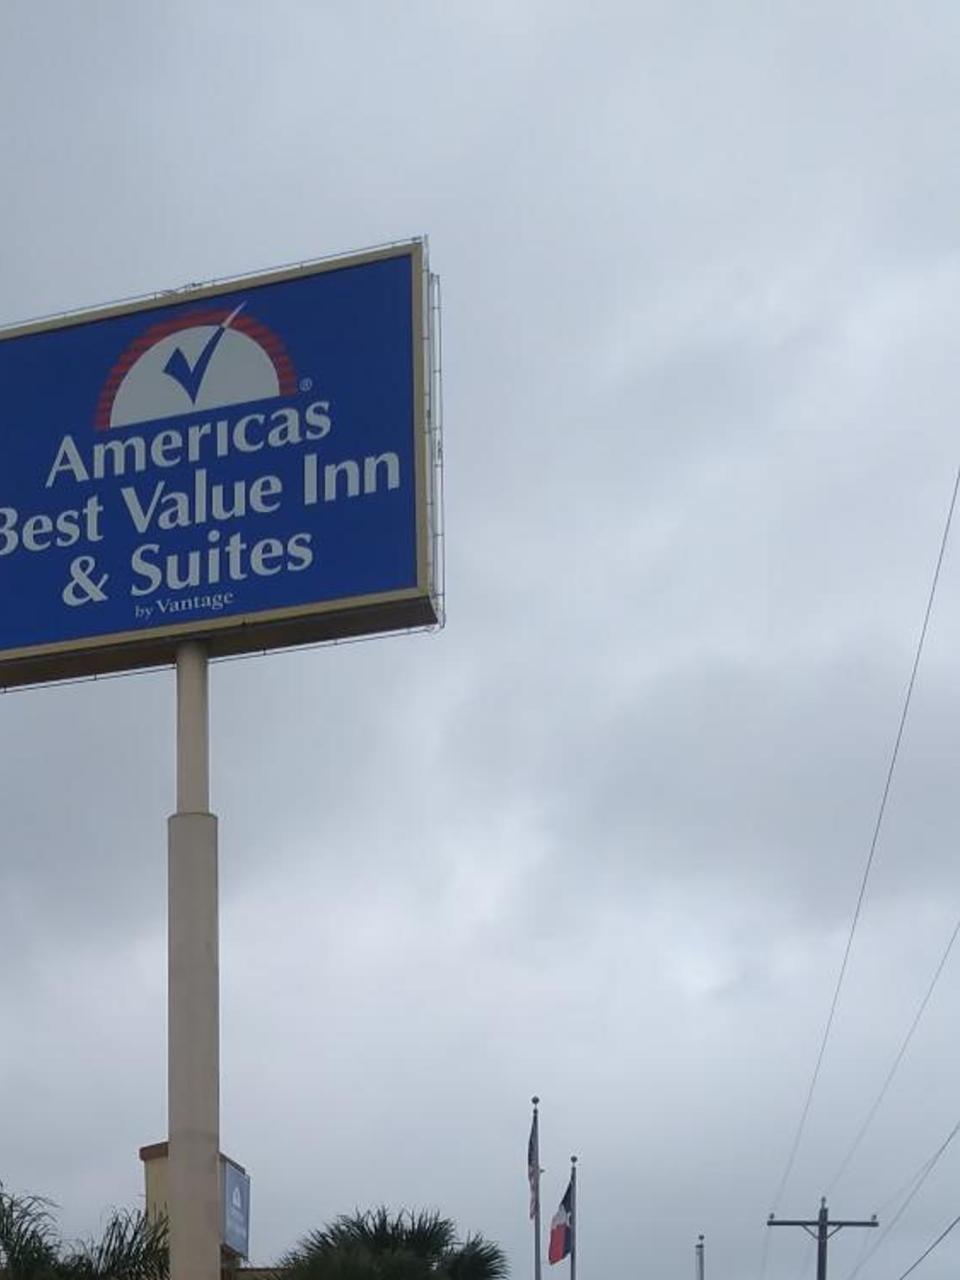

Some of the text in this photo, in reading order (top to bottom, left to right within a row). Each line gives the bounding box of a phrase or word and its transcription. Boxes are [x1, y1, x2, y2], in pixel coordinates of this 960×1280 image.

[45, 400, 332, 488] Americas
[121, 468, 283, 534] Value
[303, 450, 401, 506] Inn
[61, 529, 314, 607] & Suites
[134, 591, 235, 620] by Vantage
